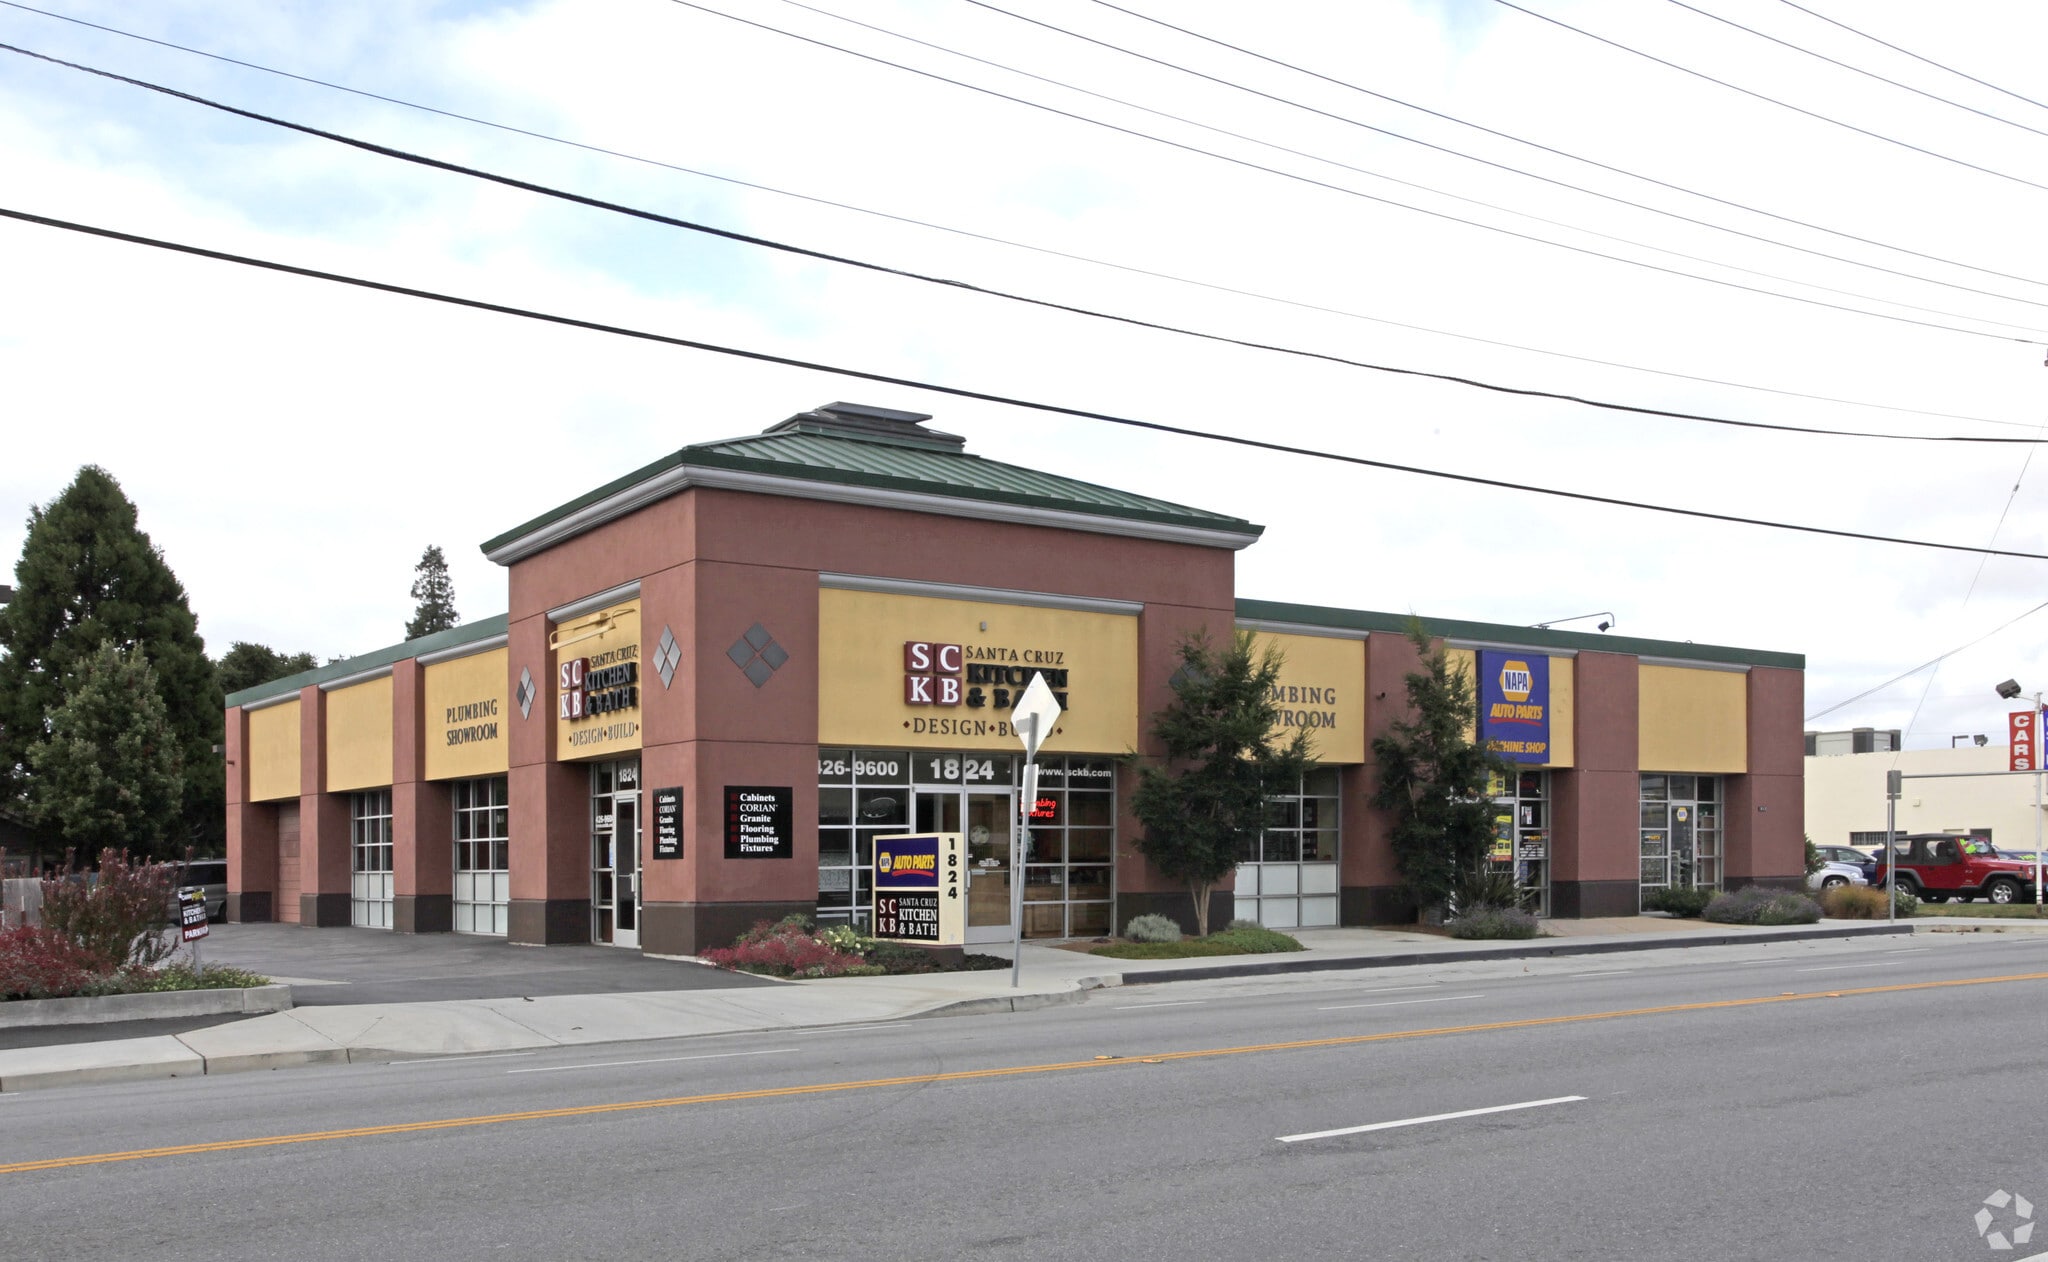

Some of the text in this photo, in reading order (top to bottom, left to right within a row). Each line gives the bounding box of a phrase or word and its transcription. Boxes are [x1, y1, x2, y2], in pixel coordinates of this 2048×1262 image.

[591, 652, 616, 668] SANTA
[617, 645, 638, 661] CRUZ
[966, 645, 1018, 661] SANTA
[1024, 648, 1064, 664] CRUZ
[584, 663, 632, 692] KITCHEN
[967, 663, 1068, 687] KITCHEN
[1504, 671, 1528, 691] NAPA
[584, 694, 592, 715] &
[596, 687, 630, 713] BATH
[966, 687, 986, 708] &
[993, 688, 1068, 711] BAH
[1272, 686, 1336, 705] MBING
[446, 699, 498, 724] PLUMBING
[1490, 703, 1543, 720] AUTO PARTS
[446, 722, 498, 746] SHOWROOM
[573, 722, 634, 746] DESIGN BUILD
[914, 717, 986, 736] DESIGN
[1525, 742, 1547, 754] SHOP
[2014, 715, 2030, 770] CARS
[619, 767, 637, 782] 1824
[740, 793, 775, 802] Cabinets
[740, 814, 771, 822] Granite
[740, 824, 775, 835] Flooring
[740, 834, 779, 845] Plumbing
[740, 844, 773, 852] Fixtures
[893, 855, 912, 870] AUTO
[912, 854, 935, 870] PARTS
[899, 897, 919, 907] SANTA
[920, 898, 937, 907] CRUZ
[899, 908, 937, 921] KITCHEN
[899, 922, 906, 935] &
[908, 923, 937, 936] BATH
